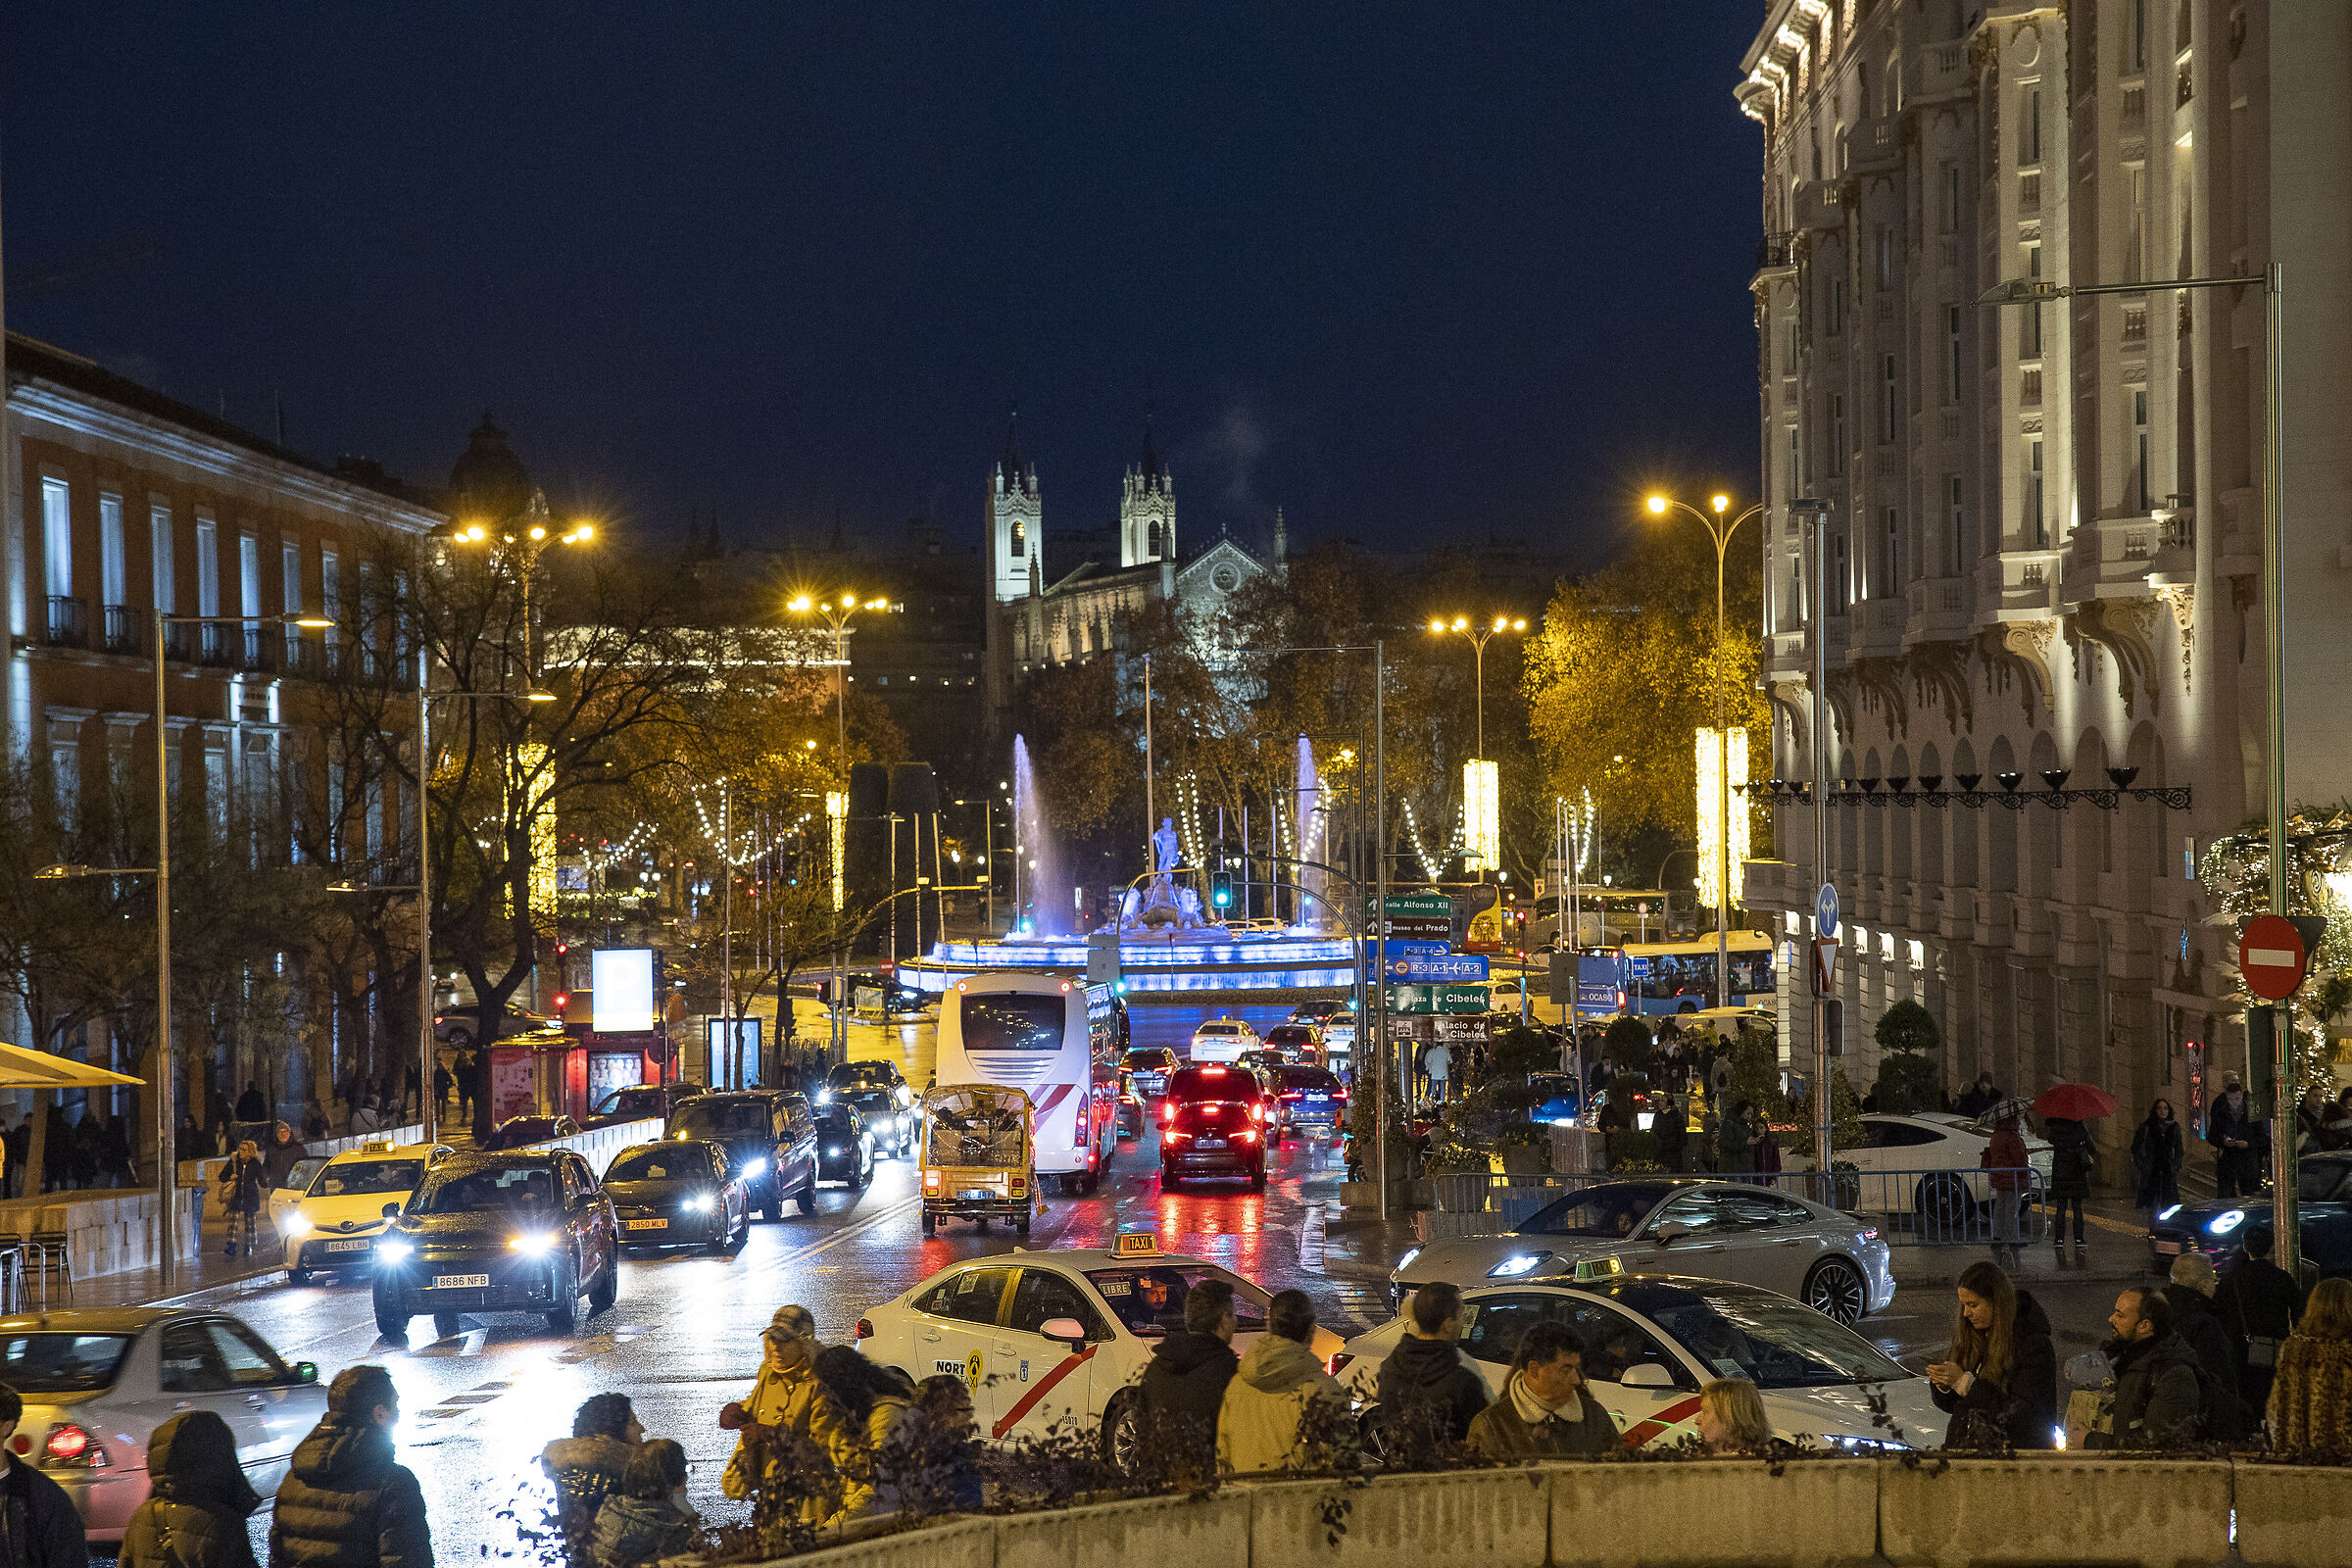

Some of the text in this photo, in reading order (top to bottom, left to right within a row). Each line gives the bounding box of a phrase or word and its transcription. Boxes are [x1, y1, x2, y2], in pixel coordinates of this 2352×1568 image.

[1403, 901, 1435, 909] Alfonso
[1437, 901, 1448, 909] XII
[1589, 993, 1613, 1003] OCASO
[1449, 1030, 1485, 1039] Cibeles
[630, 1220, 651, 1229] 2850
[329, 1241, 368, 1250] 8645 LBN
[1129, 1237, 1149, 1250] TAXI
[439, 1275, 487, 1287] 8686 NFB
[1102, 1284, 1128, 1295] LIBRE
[936, 1360, 966, 1375] NORT
